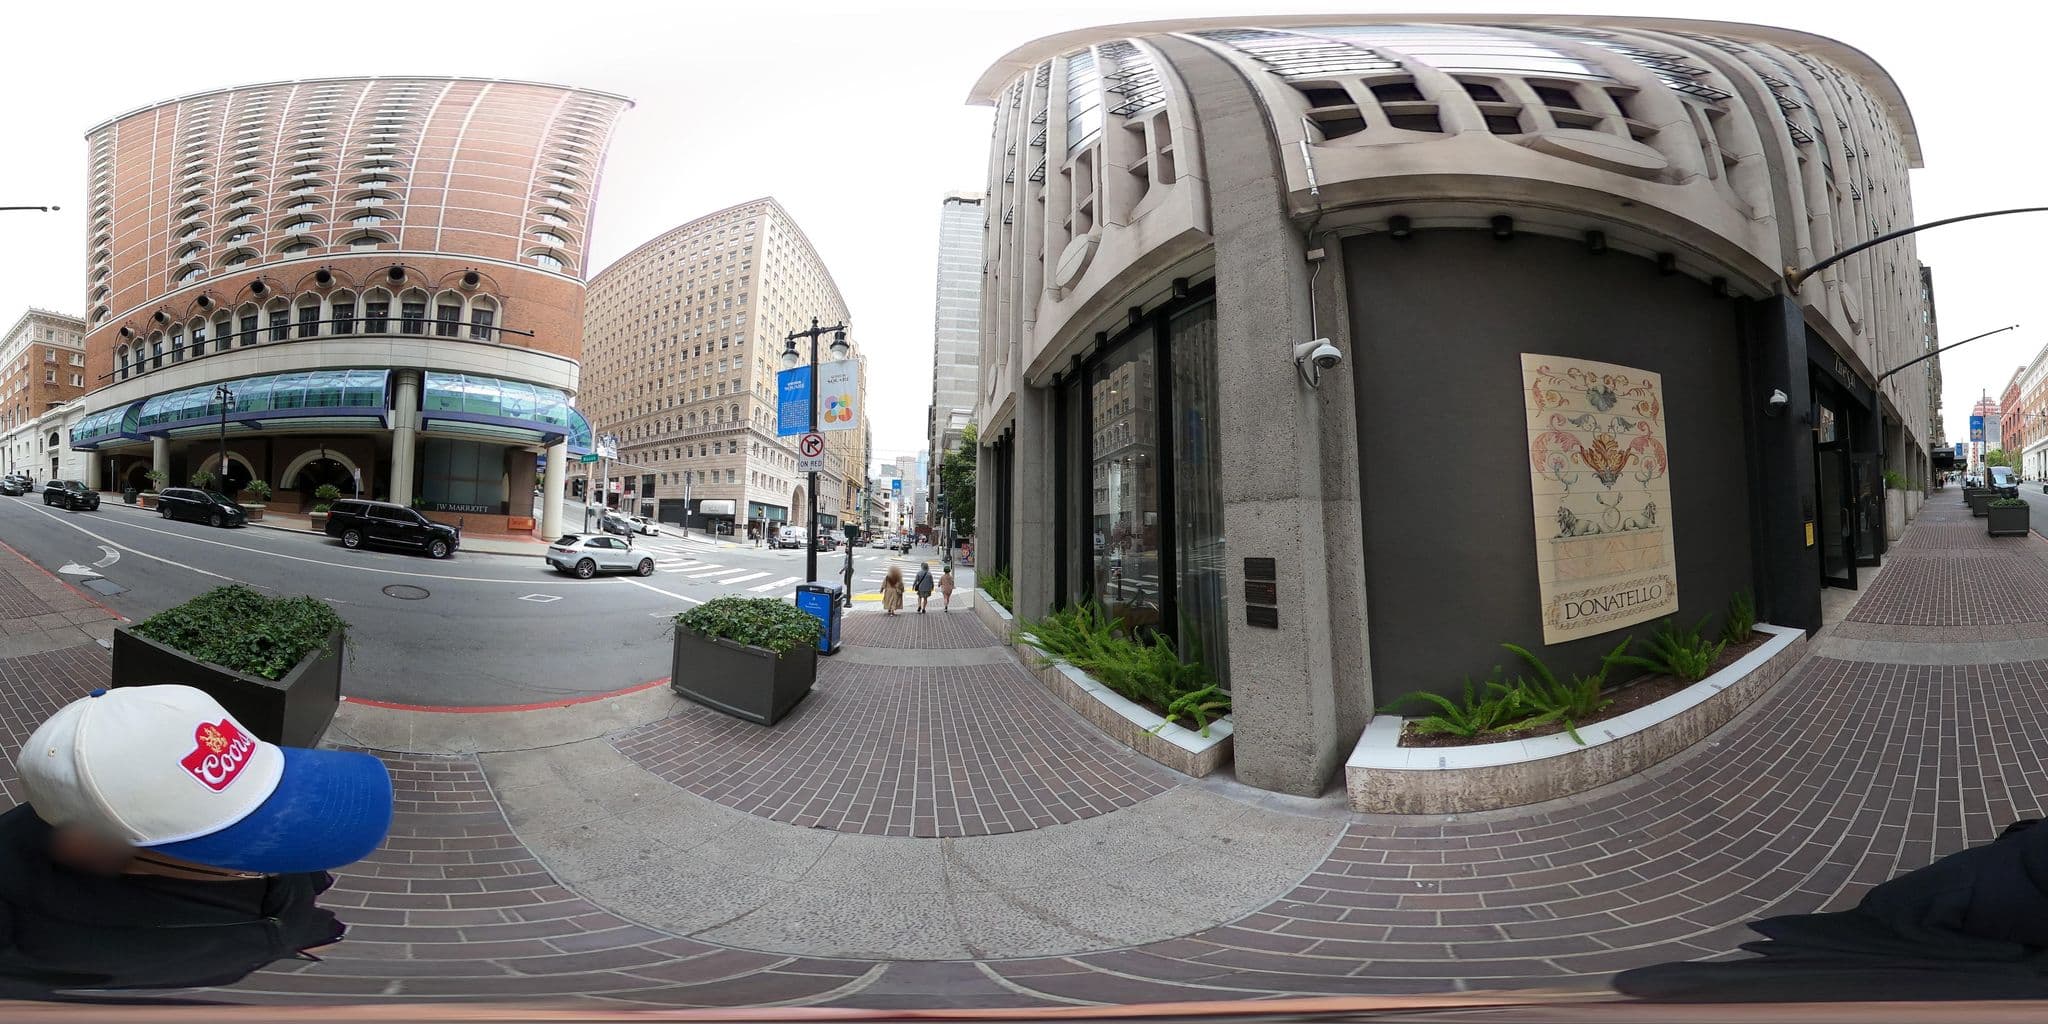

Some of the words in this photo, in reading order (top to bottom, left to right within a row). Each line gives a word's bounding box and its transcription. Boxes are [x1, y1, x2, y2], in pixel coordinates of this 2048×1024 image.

[436, 503, 447, 511] JW
[448, 504, 489, 513] MARRIOTT
[1565, 584, 1662, 619] DONATELLO
[194, 731, 251, 784] Coors
